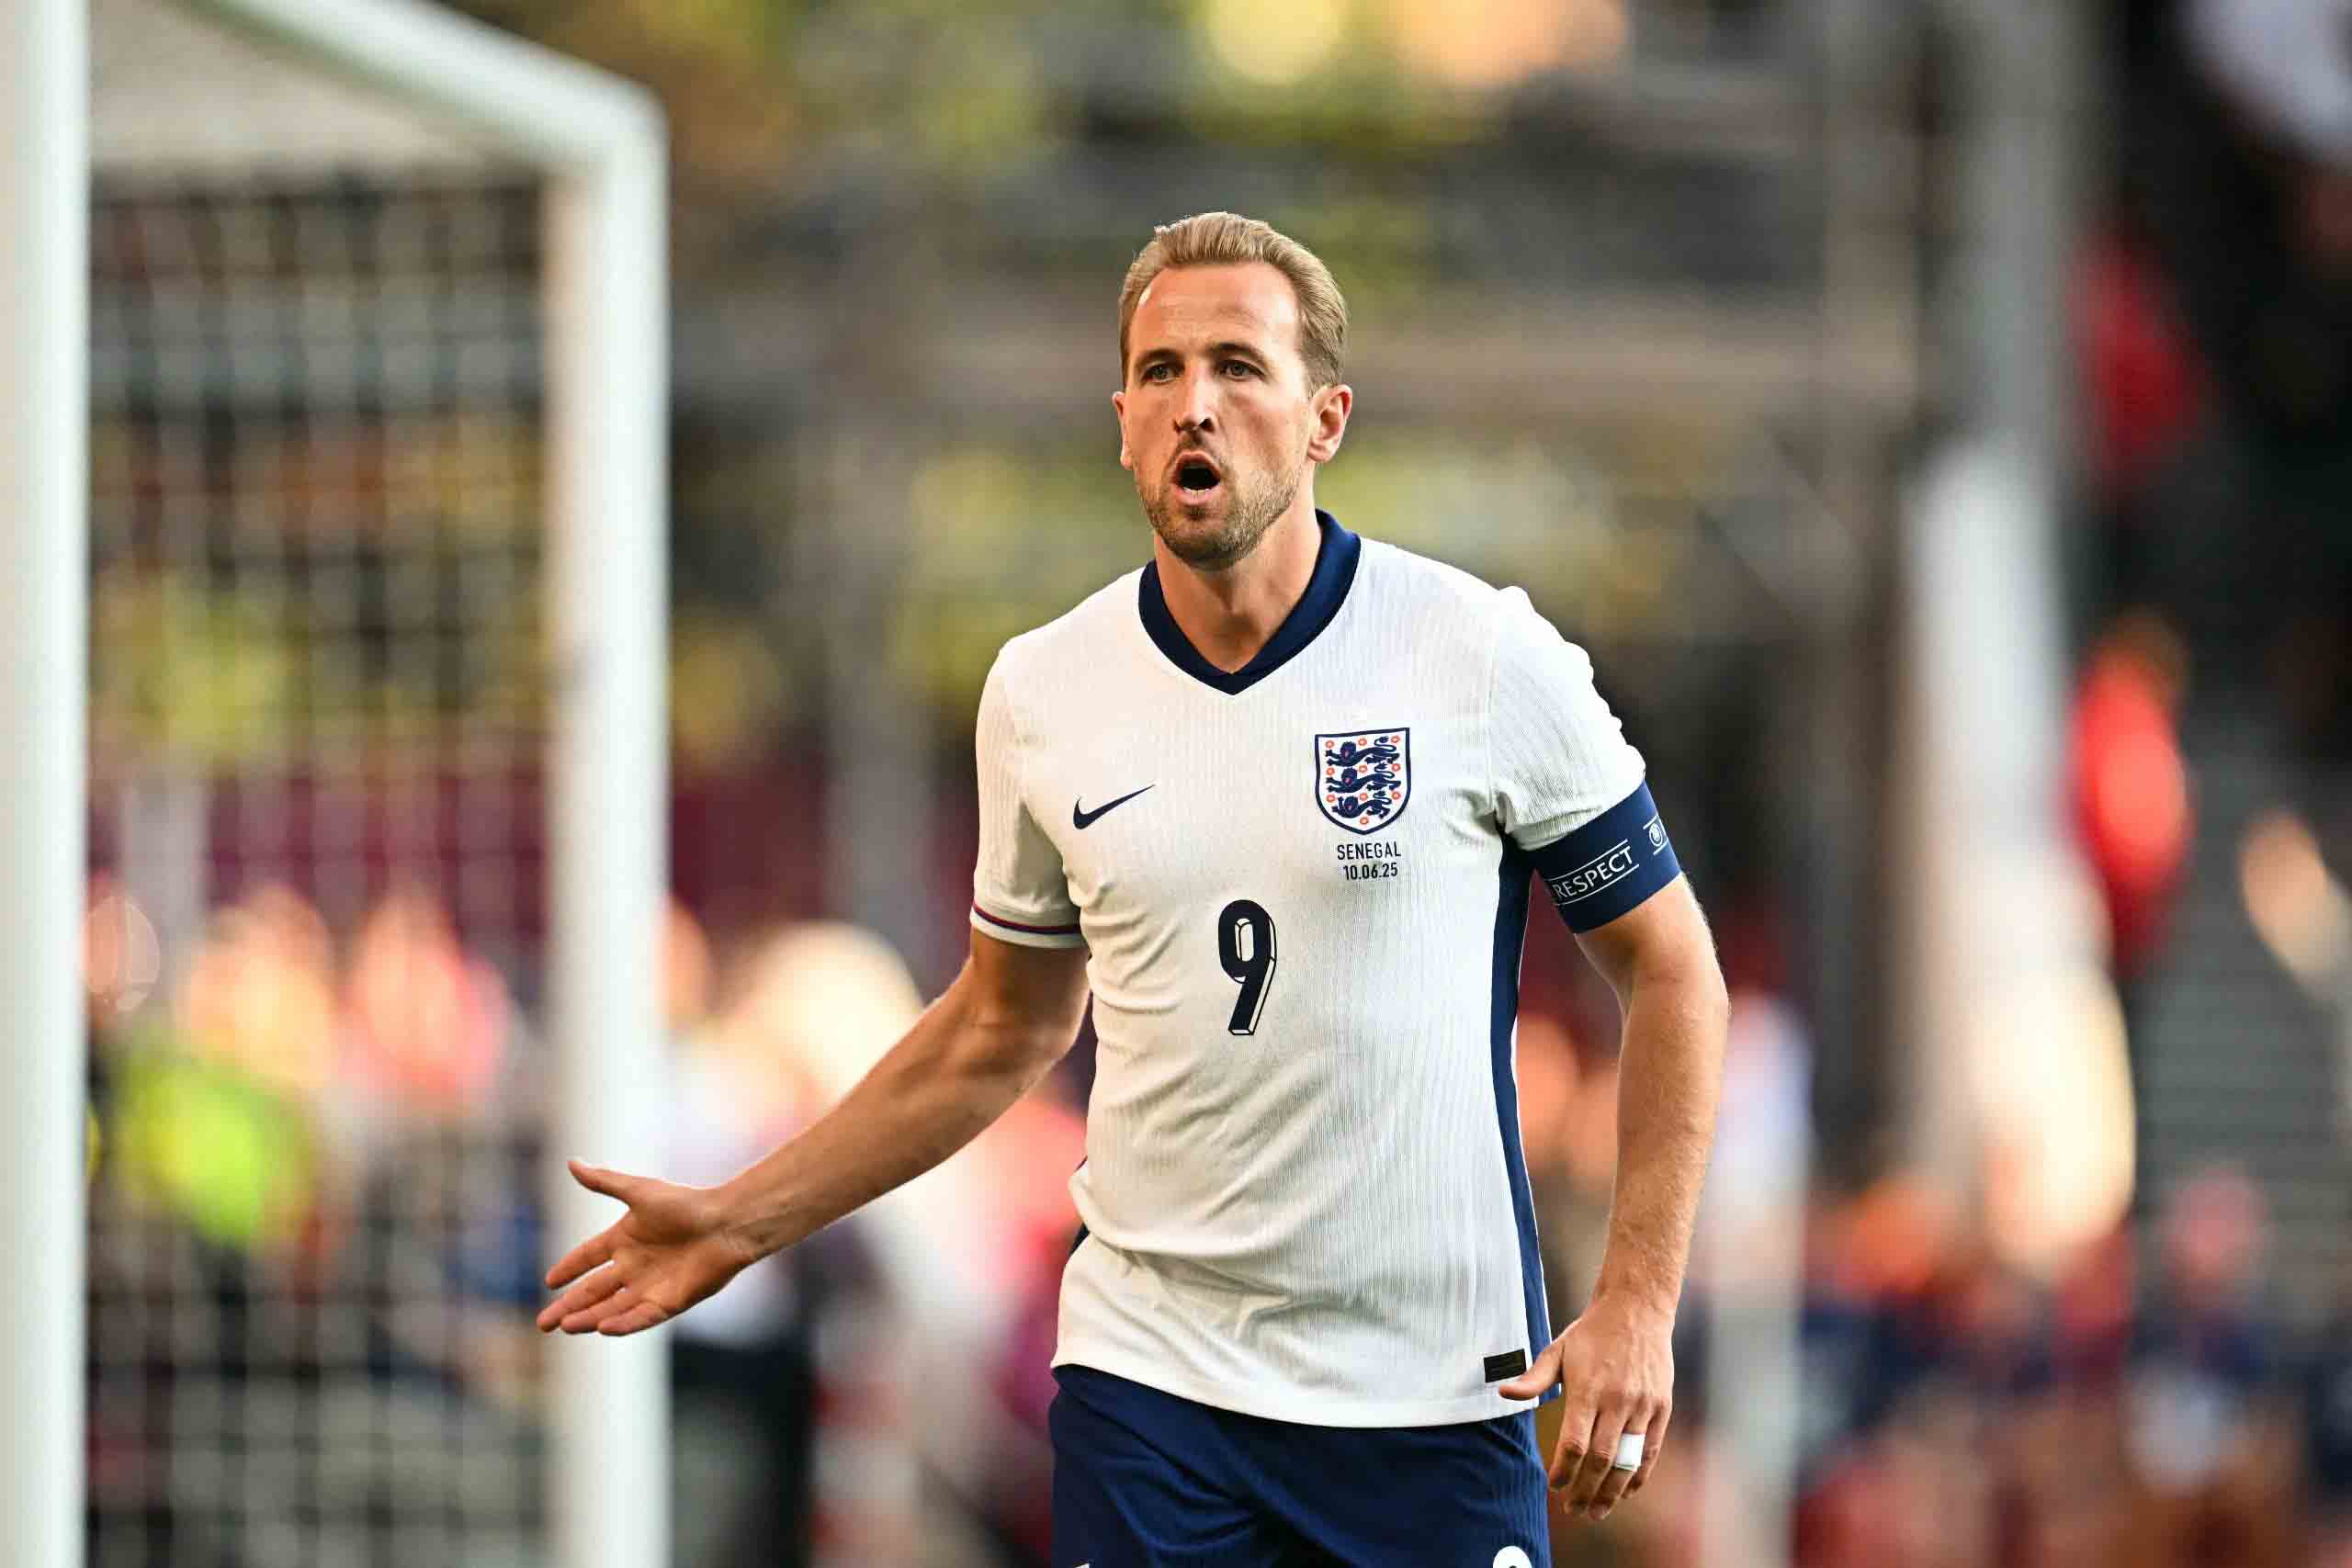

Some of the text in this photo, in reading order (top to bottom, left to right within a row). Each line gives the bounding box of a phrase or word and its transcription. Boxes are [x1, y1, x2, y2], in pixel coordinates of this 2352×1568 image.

[1337, 841, 1401, 861] SENEGAL
[1342, 863, 1398, 880] 10.06.25
[1552, 845, 1633, 900] RESPECT
[1217, 899, 1277, 1035] 9
